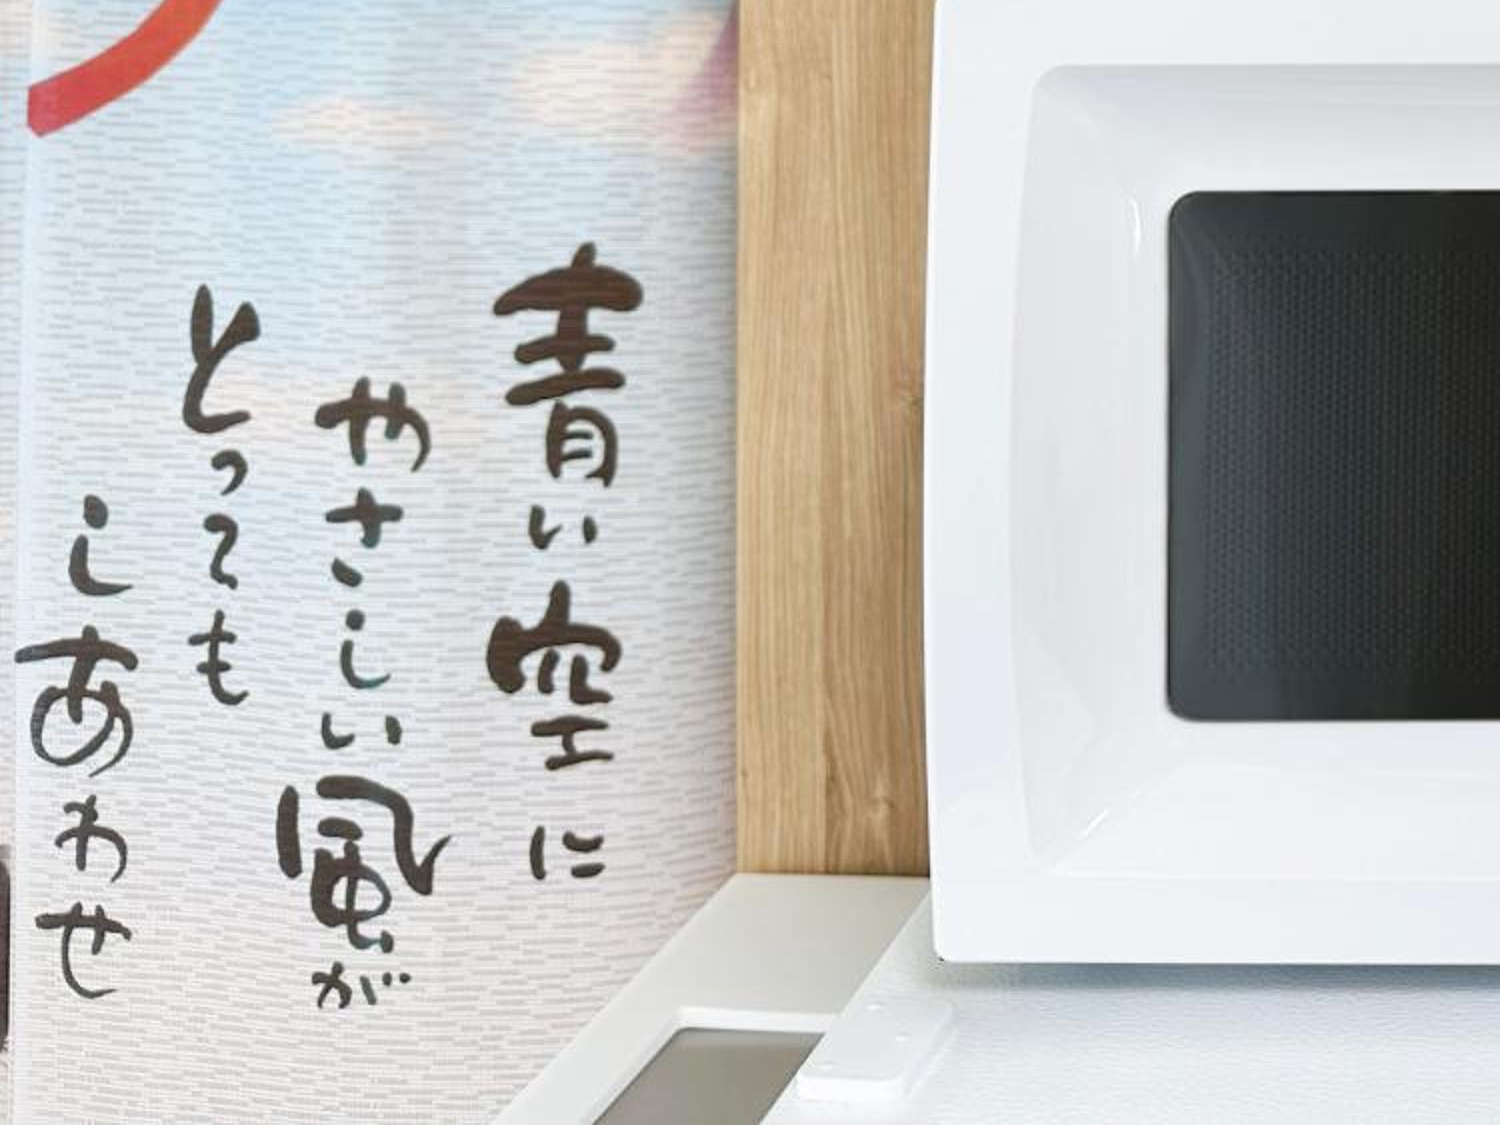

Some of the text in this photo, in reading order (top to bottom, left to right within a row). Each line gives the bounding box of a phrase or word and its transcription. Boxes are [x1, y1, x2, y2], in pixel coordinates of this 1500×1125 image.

[15, 495, 139, 1000] しあわせ
[183, 284, 261, 706] とっても
[276, 376, 451, 1010] やさしい風が
[487, 242, 643, 881] 青い空に
